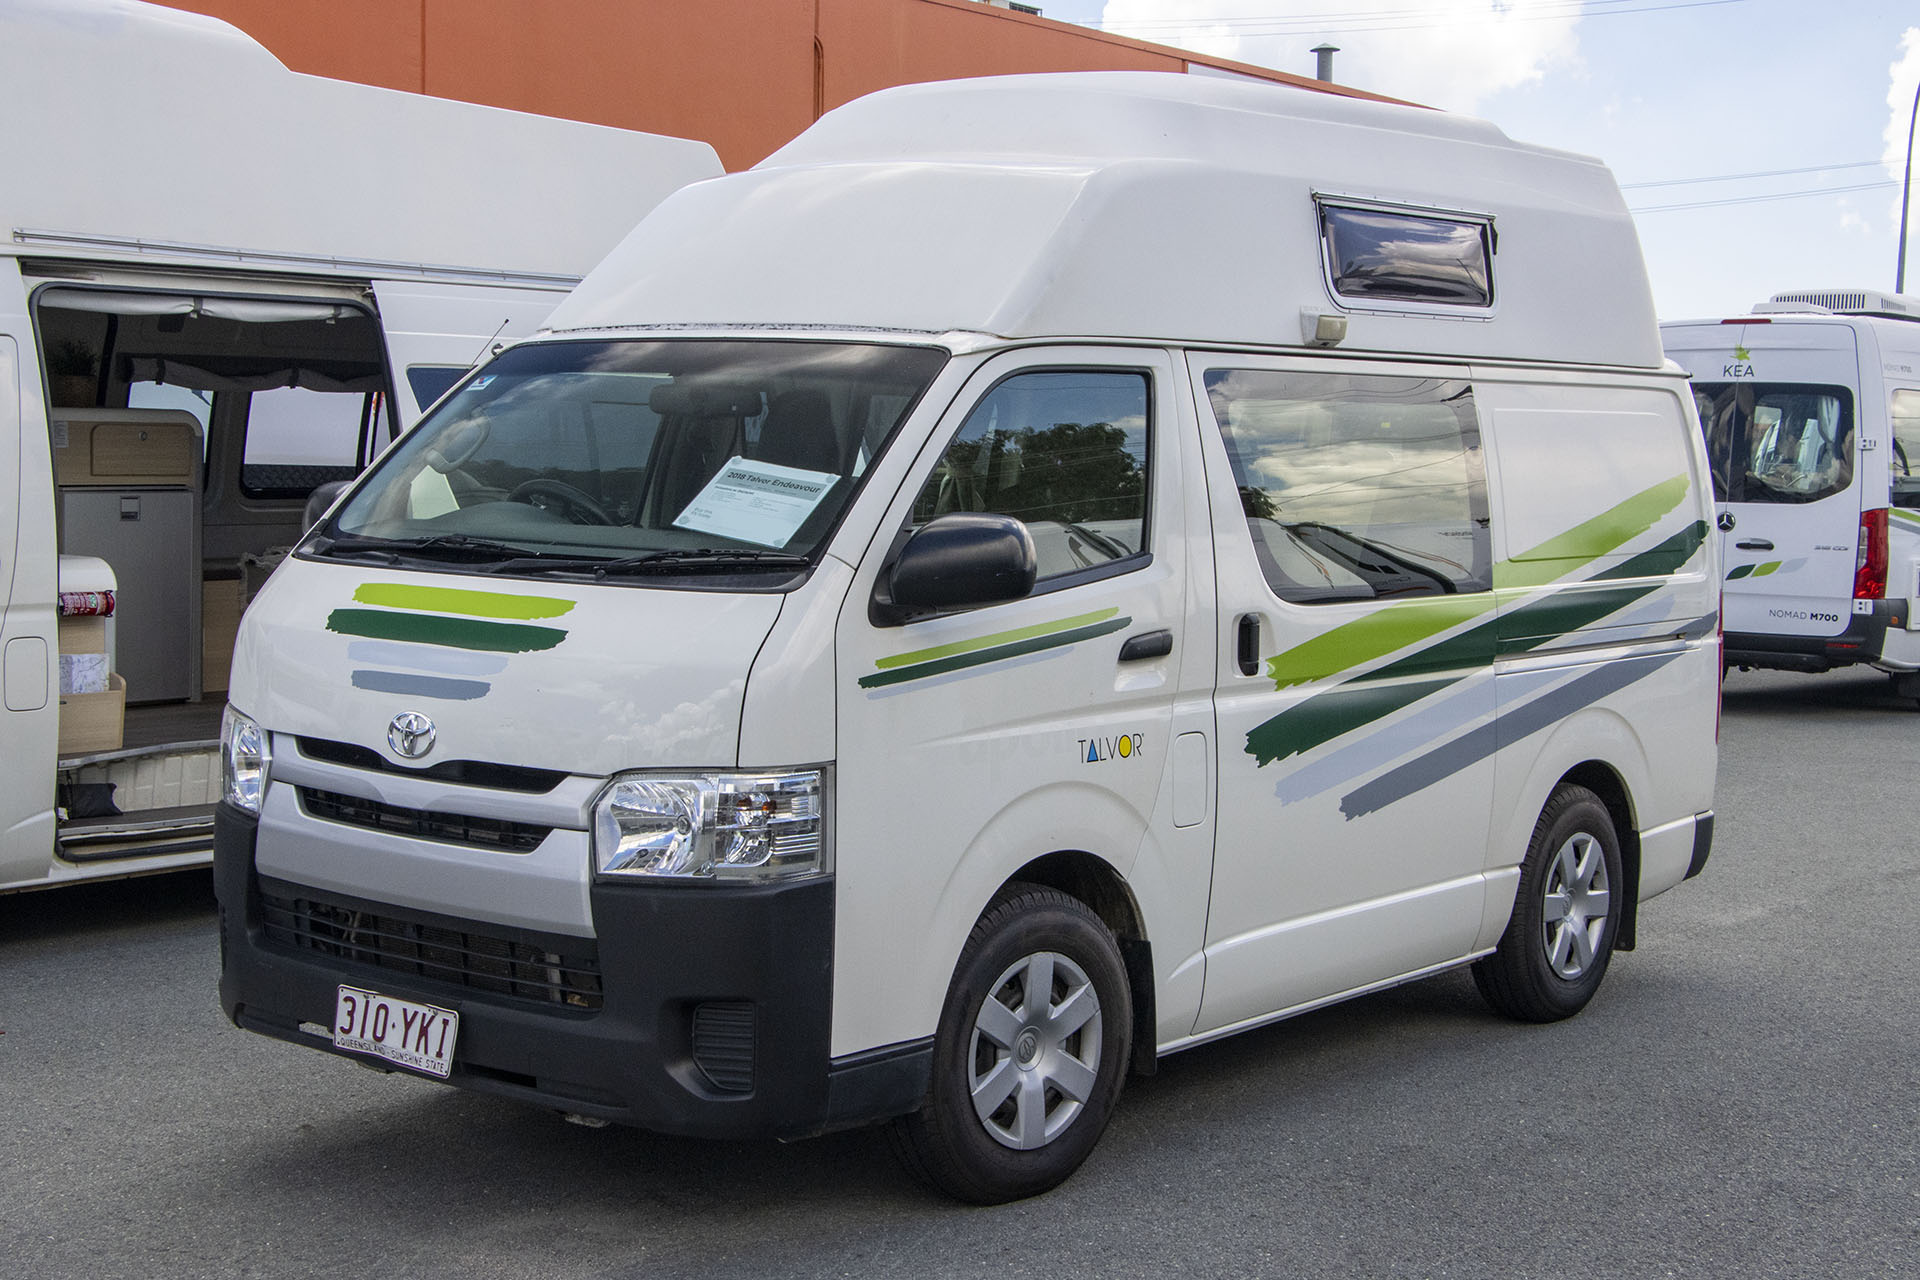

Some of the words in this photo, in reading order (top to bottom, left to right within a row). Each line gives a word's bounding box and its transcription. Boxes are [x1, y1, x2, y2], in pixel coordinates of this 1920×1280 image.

[1722, 364, 1755, 377] KEA
[727, 471, 746, 480] 2018
[746, 475, 770, 485] Talvor
[771, 479, 821, 493] Endeavour
[1769, 609, 1808, 620] NOMAD
[1809, 612, 1839, 622] M700
[1077, 733, 1142, 763] TALVOR
[340, 1038, 385, 1055] QUEENSLAND
[426, 1059, 445, 1073] STATE
